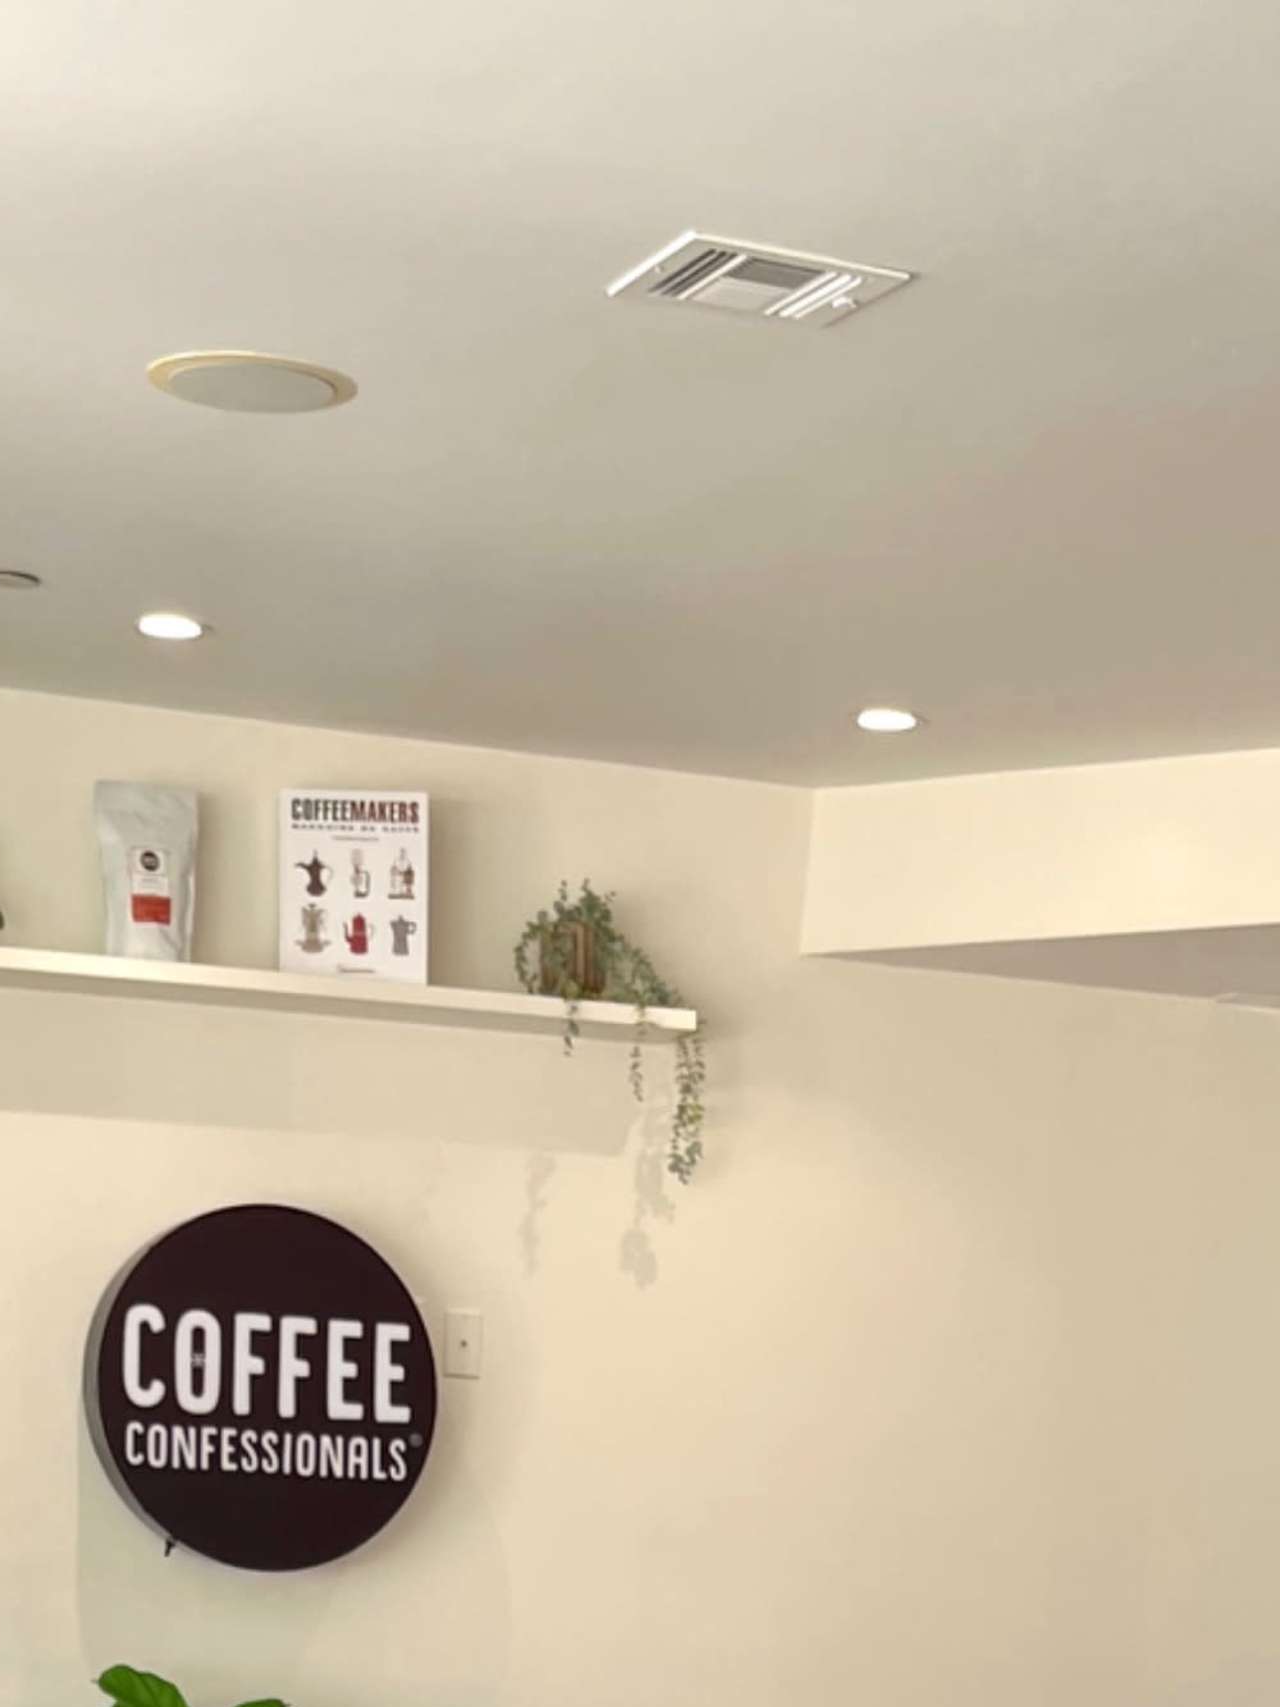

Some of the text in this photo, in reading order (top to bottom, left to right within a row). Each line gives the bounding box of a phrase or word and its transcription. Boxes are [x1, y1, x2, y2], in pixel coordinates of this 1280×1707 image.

[290, 797, 419, 823] COFFEEMAKERS
[122, 1303, 412, 1423] COFFEE
[125, 1421, 408, 1482] CONFESSIONALS
